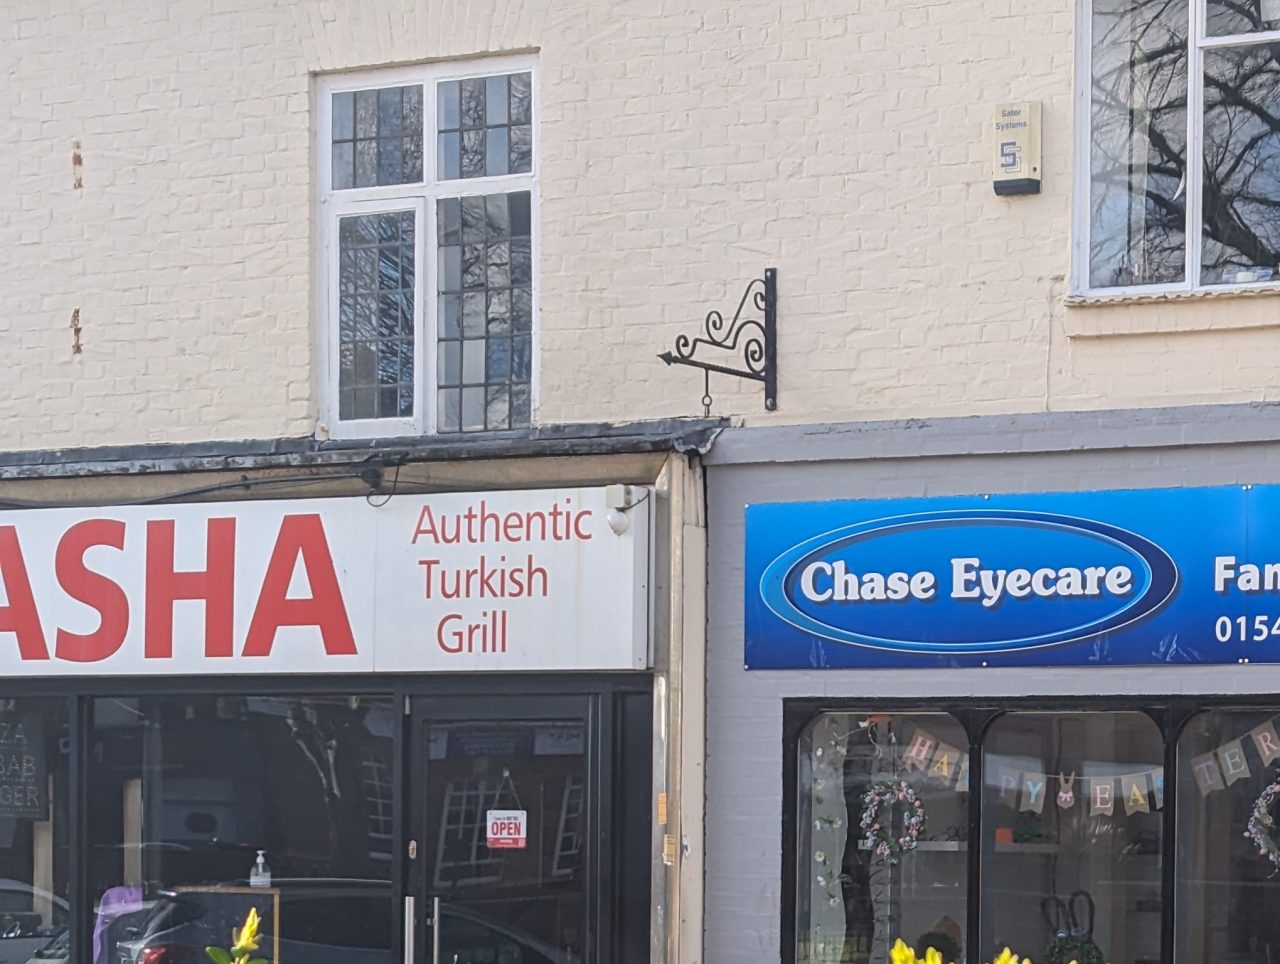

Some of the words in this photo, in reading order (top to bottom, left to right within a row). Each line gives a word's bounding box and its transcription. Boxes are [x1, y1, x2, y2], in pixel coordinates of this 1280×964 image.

[995, 121, 1027, 131] Systems
[411, 498, 594, 546] Authentic
[418, 554, 549, 600] Turkish
[800, 560, 936, 602] Chase
[949, 556, 1133, 608] Eyecare
[437, 611, 508, 655] Grill
[491, 821, 522, 836] OPEN
